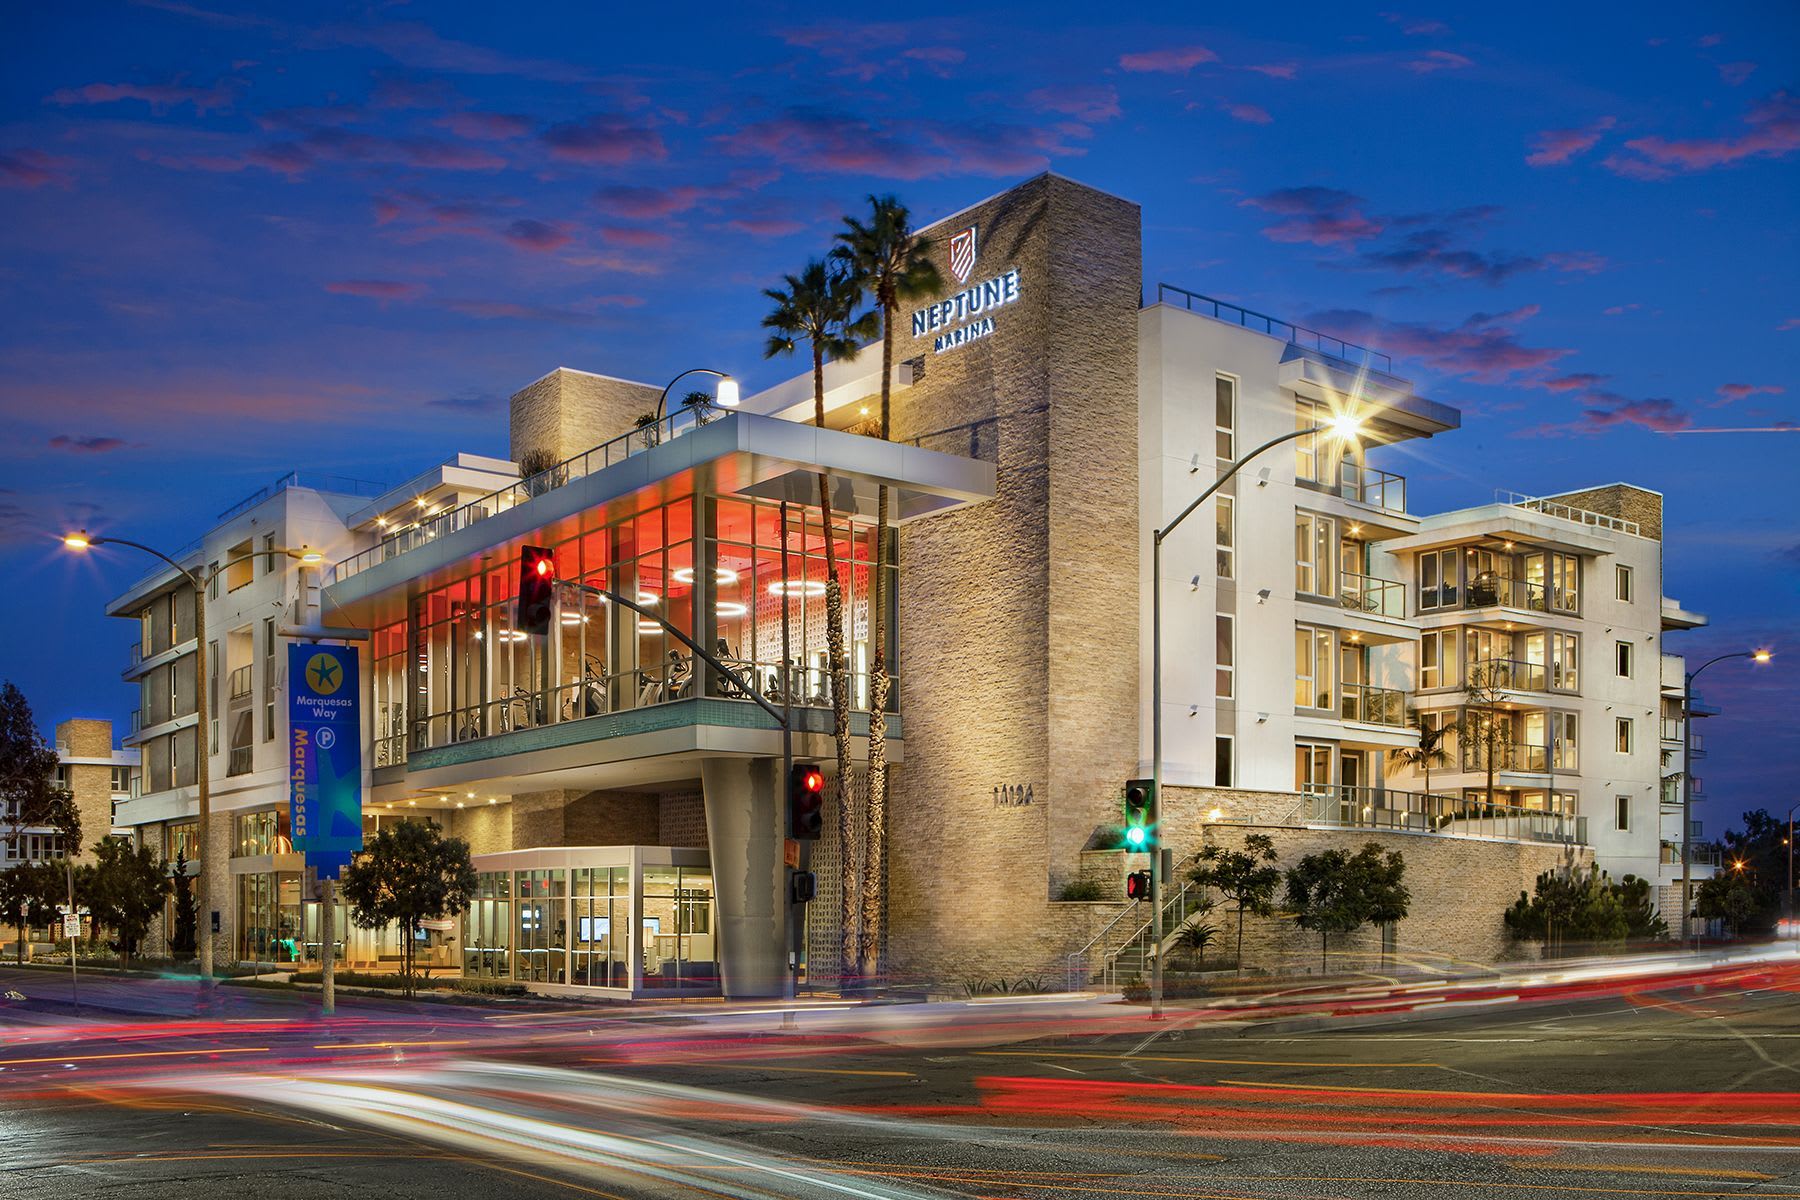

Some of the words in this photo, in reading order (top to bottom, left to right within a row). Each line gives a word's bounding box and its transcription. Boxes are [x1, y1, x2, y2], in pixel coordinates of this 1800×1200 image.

[911, 269, 1021, 338] NEPTUNE
[934, 316, 996, 353] MARINA
[297, 696, 352, 708] Marquesas
[313, 708, 337, 720] Way
[321, 731, 332, 745] P
[292, 729, 308, 836] Marquesas
